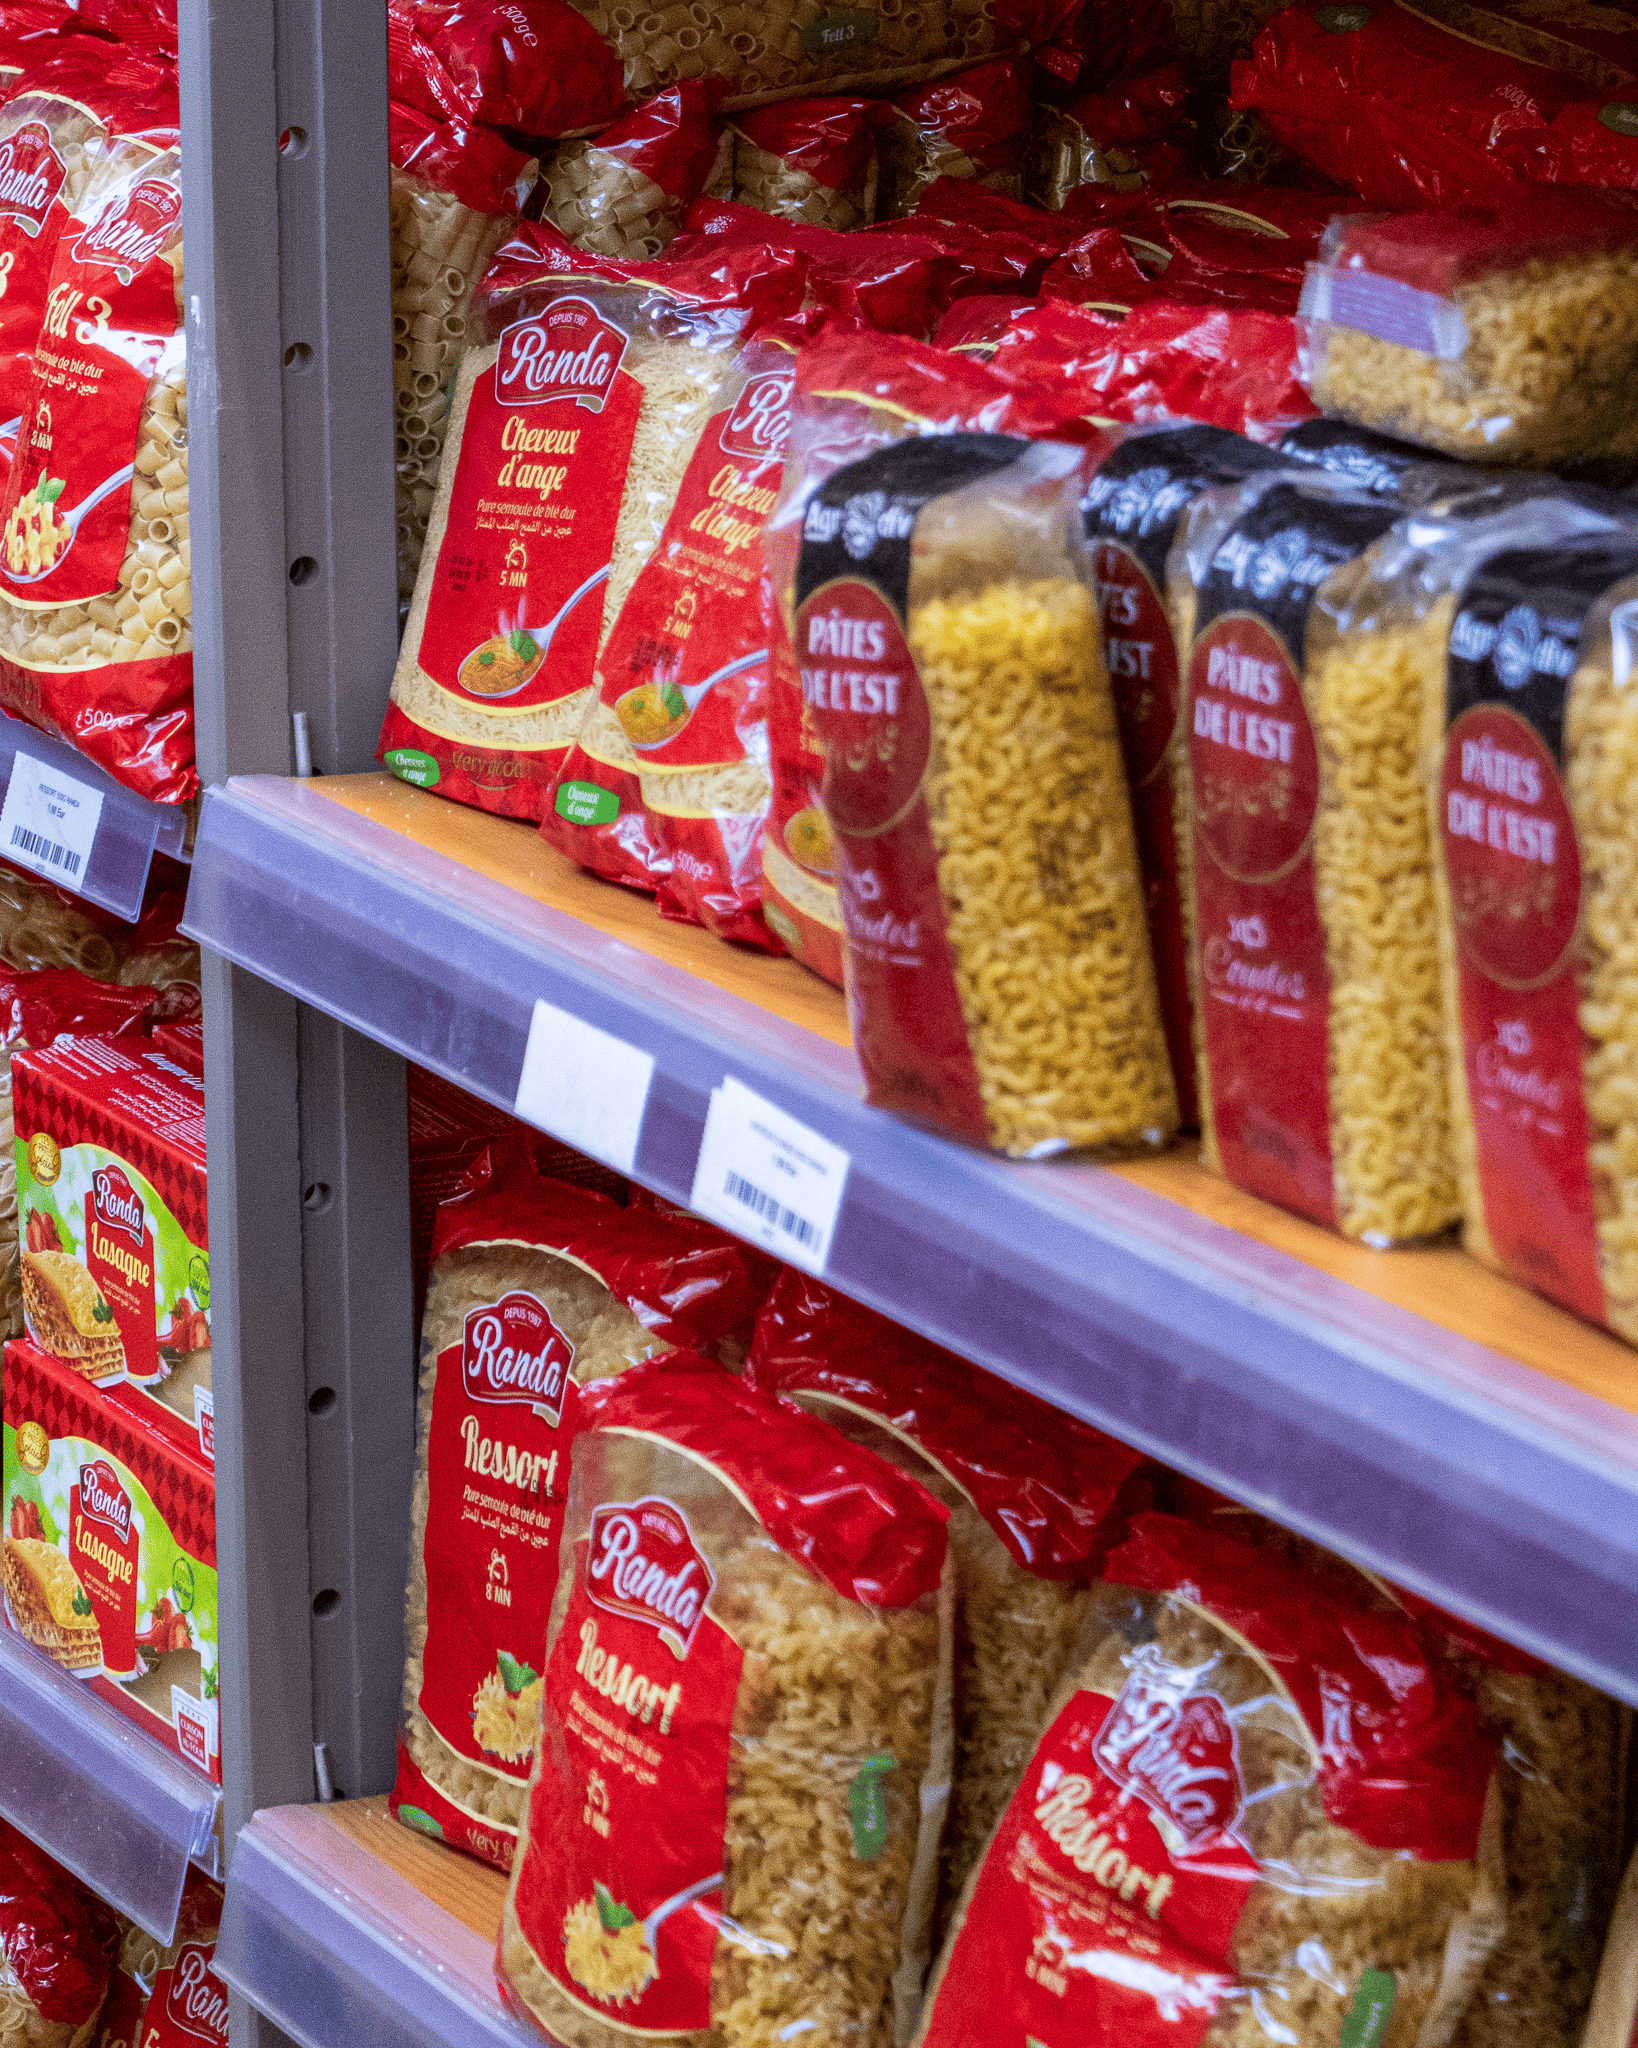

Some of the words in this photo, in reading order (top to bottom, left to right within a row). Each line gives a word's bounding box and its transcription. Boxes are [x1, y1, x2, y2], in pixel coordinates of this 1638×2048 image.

[135, 189, 161, 206] DEPUIS
[158, 196, 174, 214] 1987
[75, 296, 112, 345] 3
[549, 312, 573, 326] DEPUIS
[84, 363, 104, 379] dur
[502, 326, 611, 391] Randa
[501, 415, 581, 454] Cheveux
[497, 453, 568, 500] d'ange
[708, 464, 778, 514] Cheveu
[477, 499, 496, 513] Pure
[495, 502, 533, 516] semoule
[532, 504, 545, 517] de
[544, 505, 560, 519] blé
[560, 506, 577, 520] dur
[690, 501, 763, 555] d'ange
[499, 571, 507, 586] 5
[97, 1174, 141, 1229] Randa
[91, 1222, 150, 1288] Lasagne
[468, 1315, 561, 1398] Randa
[461, 1415, 558, 1497] Ressort
[83, 1467, 129, 1527] Randa
[463, 1484, 480, 1504] Pure
[75, 1515, 133, 1585] Lasagne
[592, 1514, 699, 1629] Randa
[485, 1582, 493, 1601] 8
[576, 1616, 682, 1734] Ressort
[1035, 1774, 1173, 1919] Ressort
